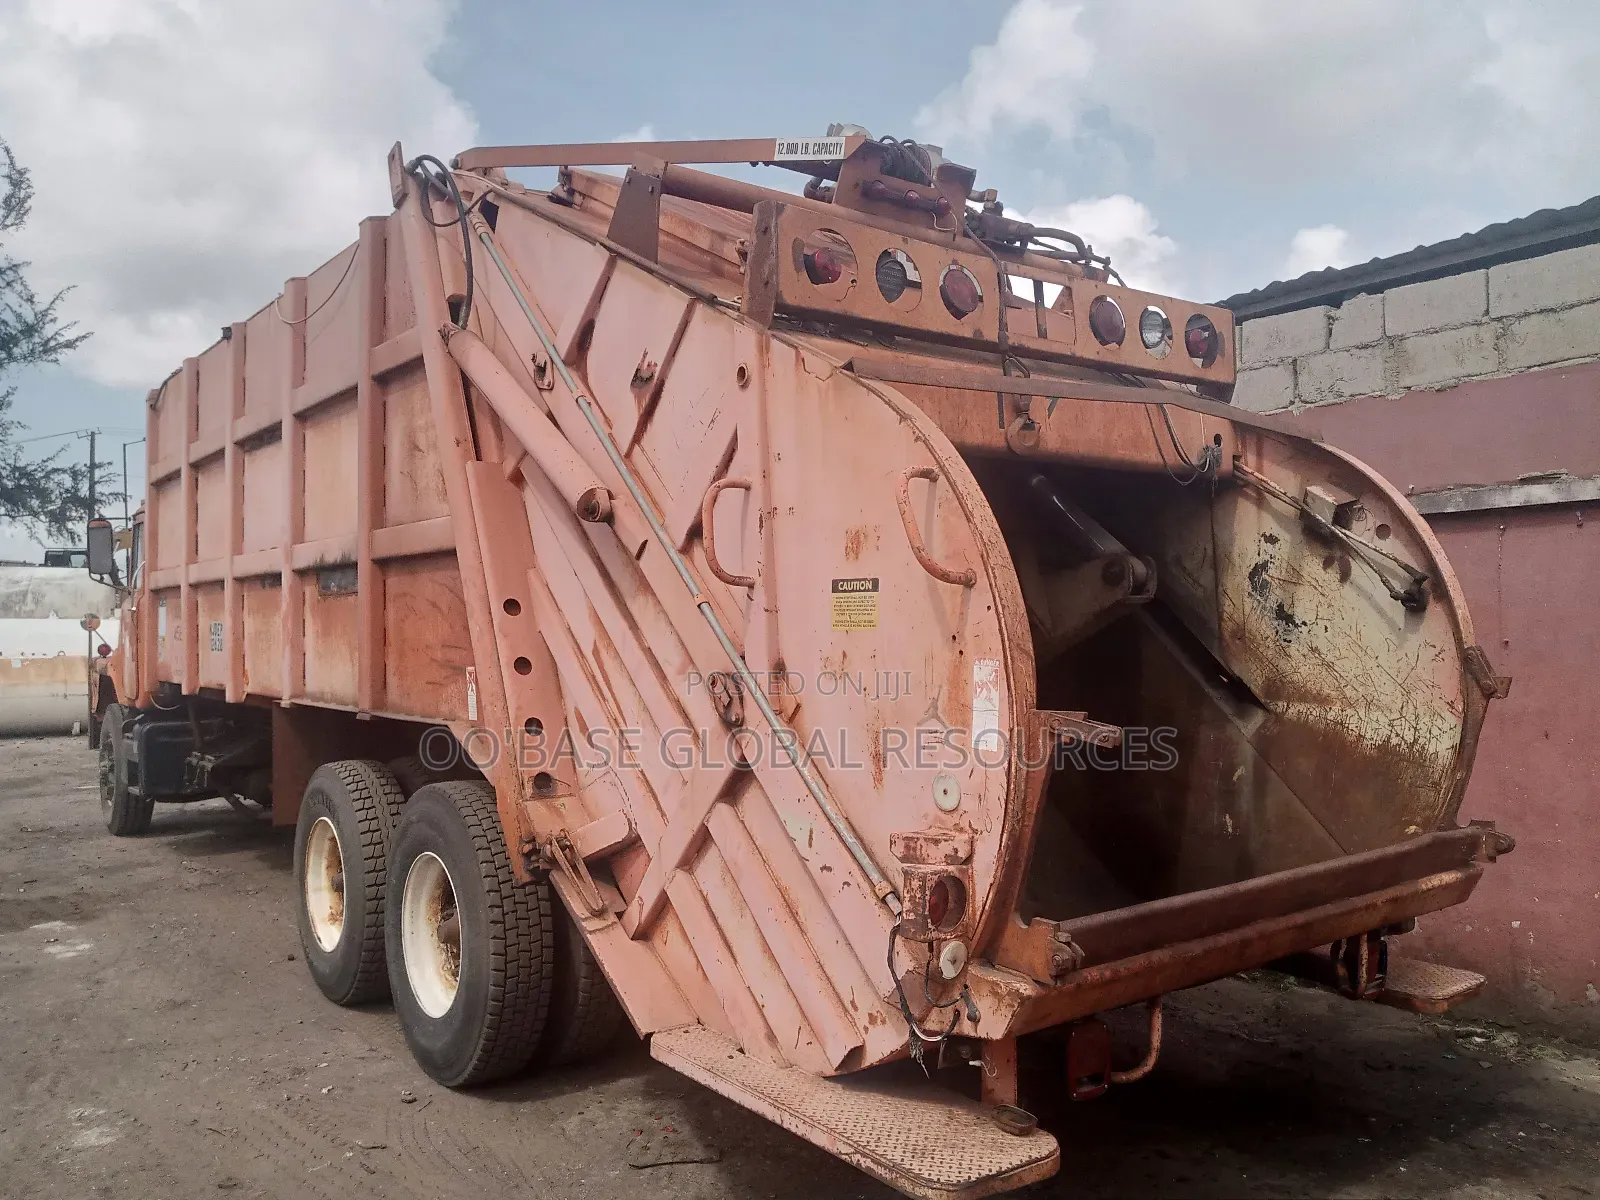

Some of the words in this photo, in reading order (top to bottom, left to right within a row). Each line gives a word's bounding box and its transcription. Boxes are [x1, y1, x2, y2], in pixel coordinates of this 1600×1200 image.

[777, 142, 799, 155] 12,000
[800, 142, 811, 155] LB.
[812, 142, 844, 155] CAPACITY
[838, 580, 873, 591] CAUTION
